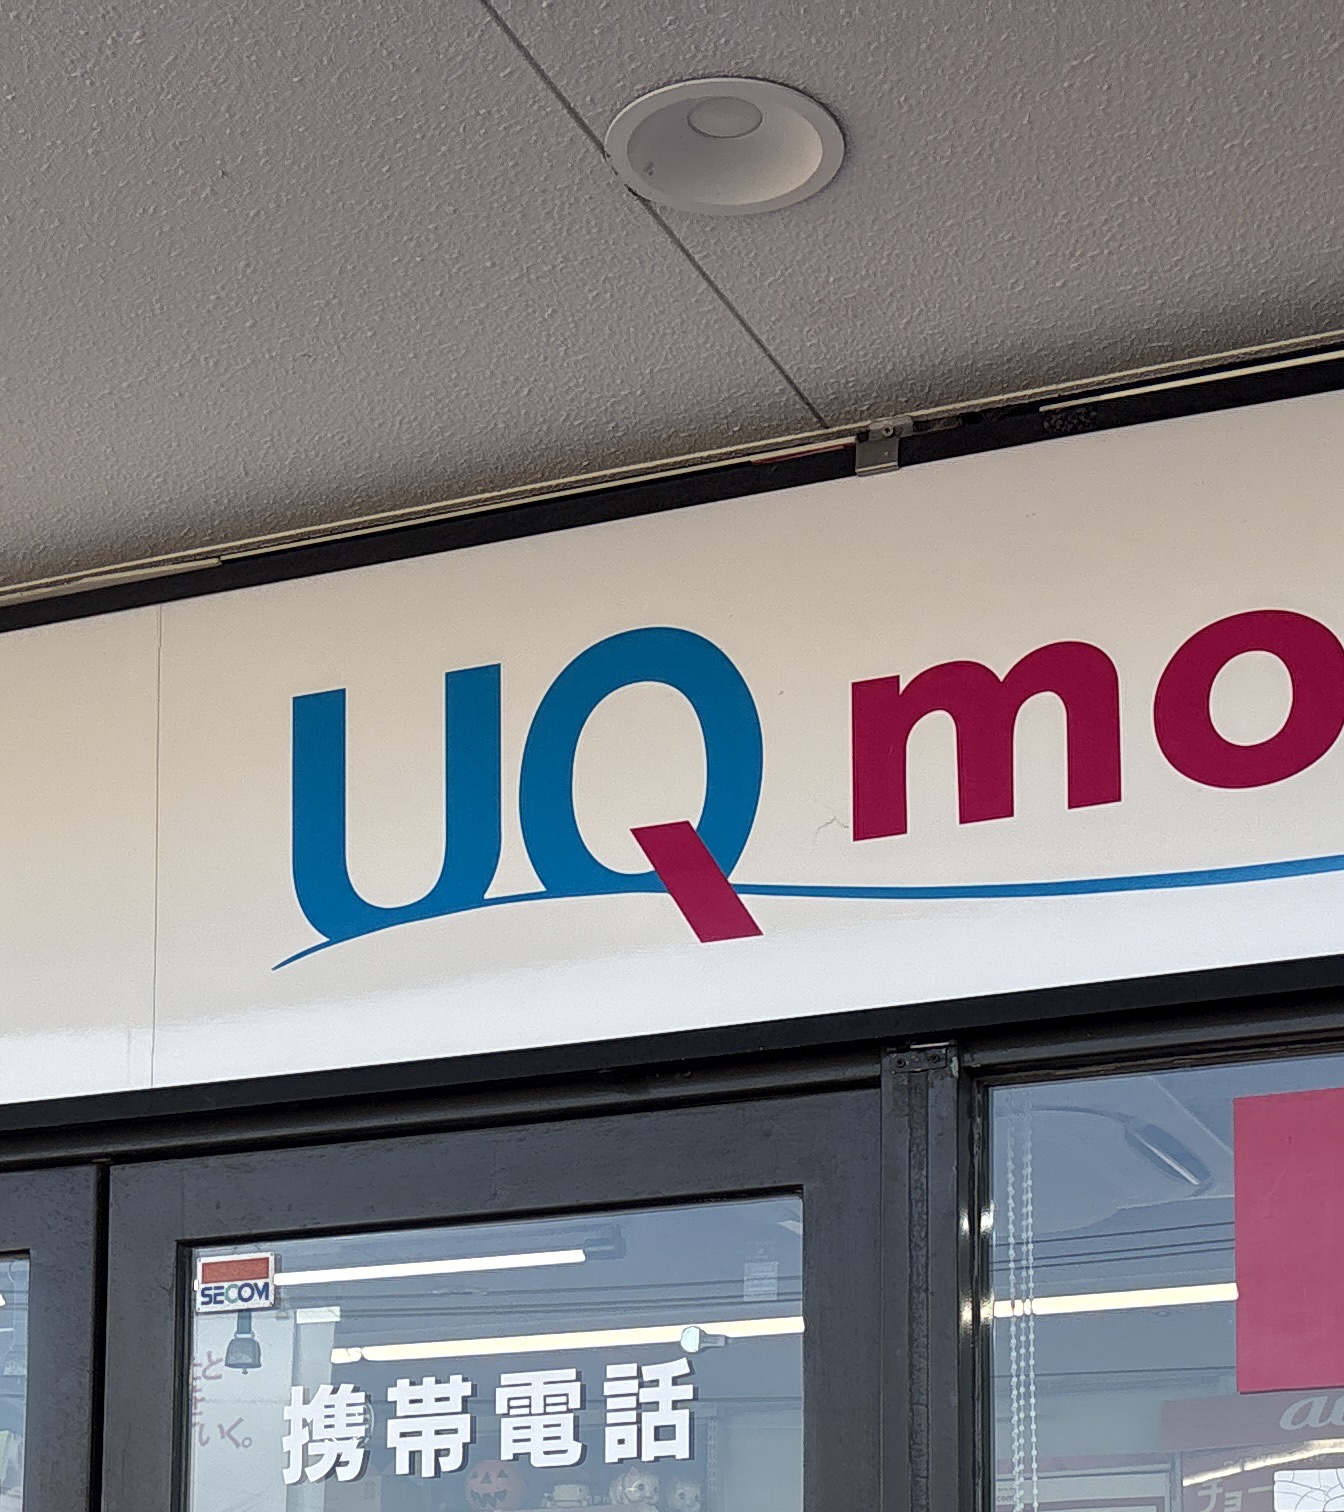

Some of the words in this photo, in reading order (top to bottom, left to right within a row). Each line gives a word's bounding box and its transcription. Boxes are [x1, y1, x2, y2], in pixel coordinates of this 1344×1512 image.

[290, 626, 765, 945] UQ
[200, 1282, 270, 1306] SECOM
[282, 1357, 695, 1485] 携帯電話
